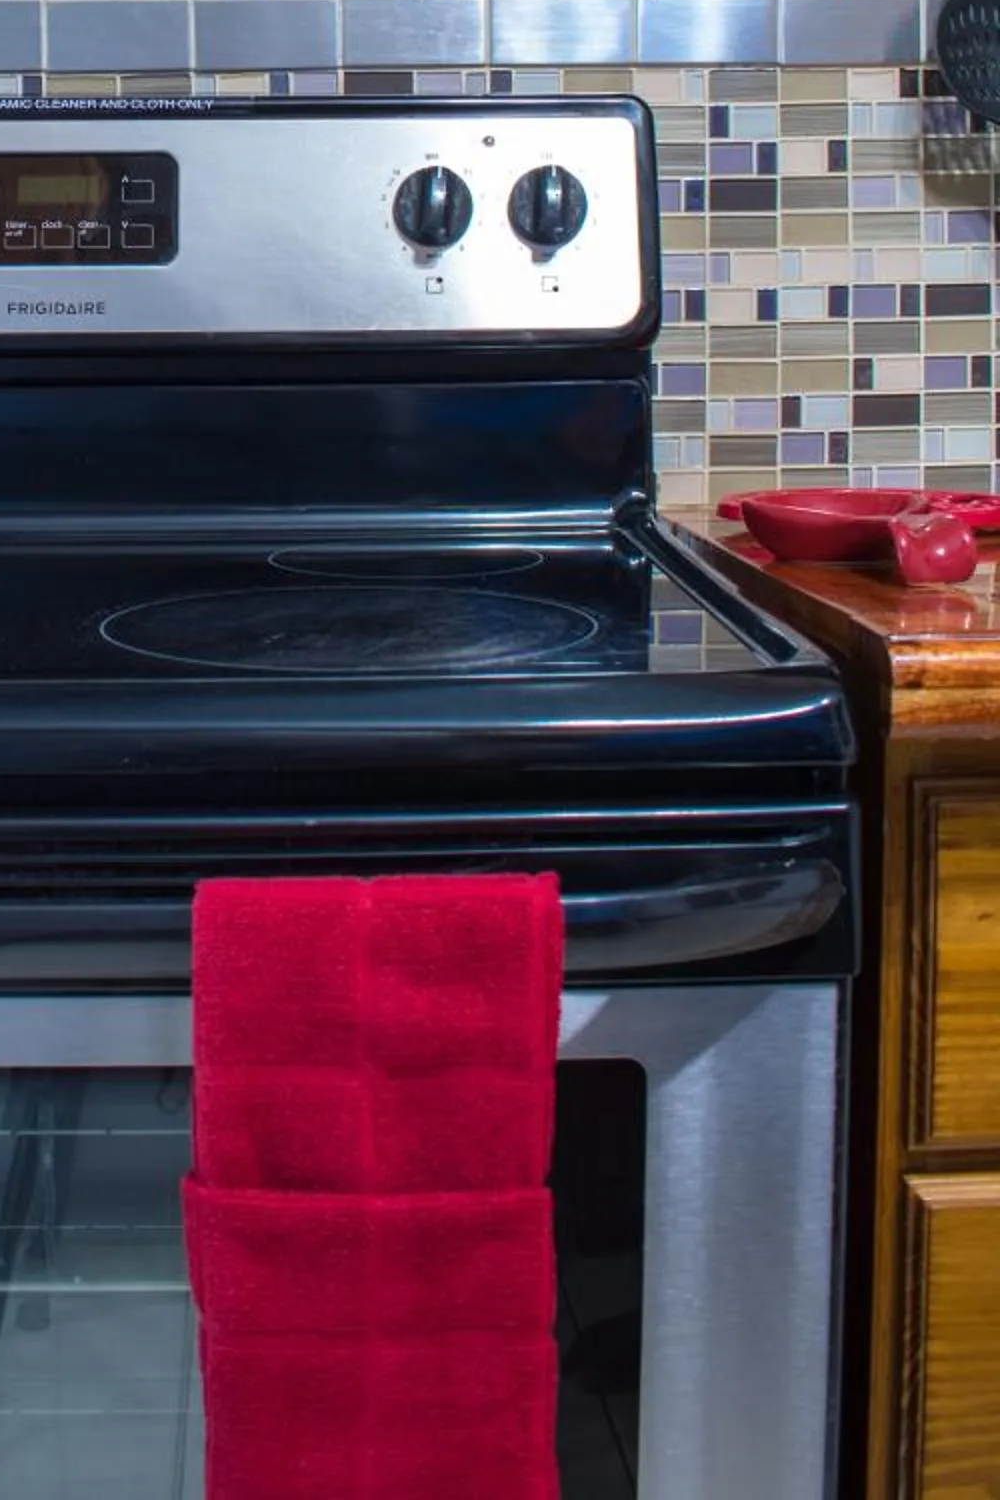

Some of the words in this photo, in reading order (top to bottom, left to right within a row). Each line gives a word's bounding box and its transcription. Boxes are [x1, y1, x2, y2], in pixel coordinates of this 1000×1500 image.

[34, 98, 97, 110] CLEANER
[100, 98, 129, 110] AND
[131, 98, 175, 110] CLOTH
[176, 98, 214, 110] ONLY
[7, 301, 105, 315] FRIGIDAIRE
